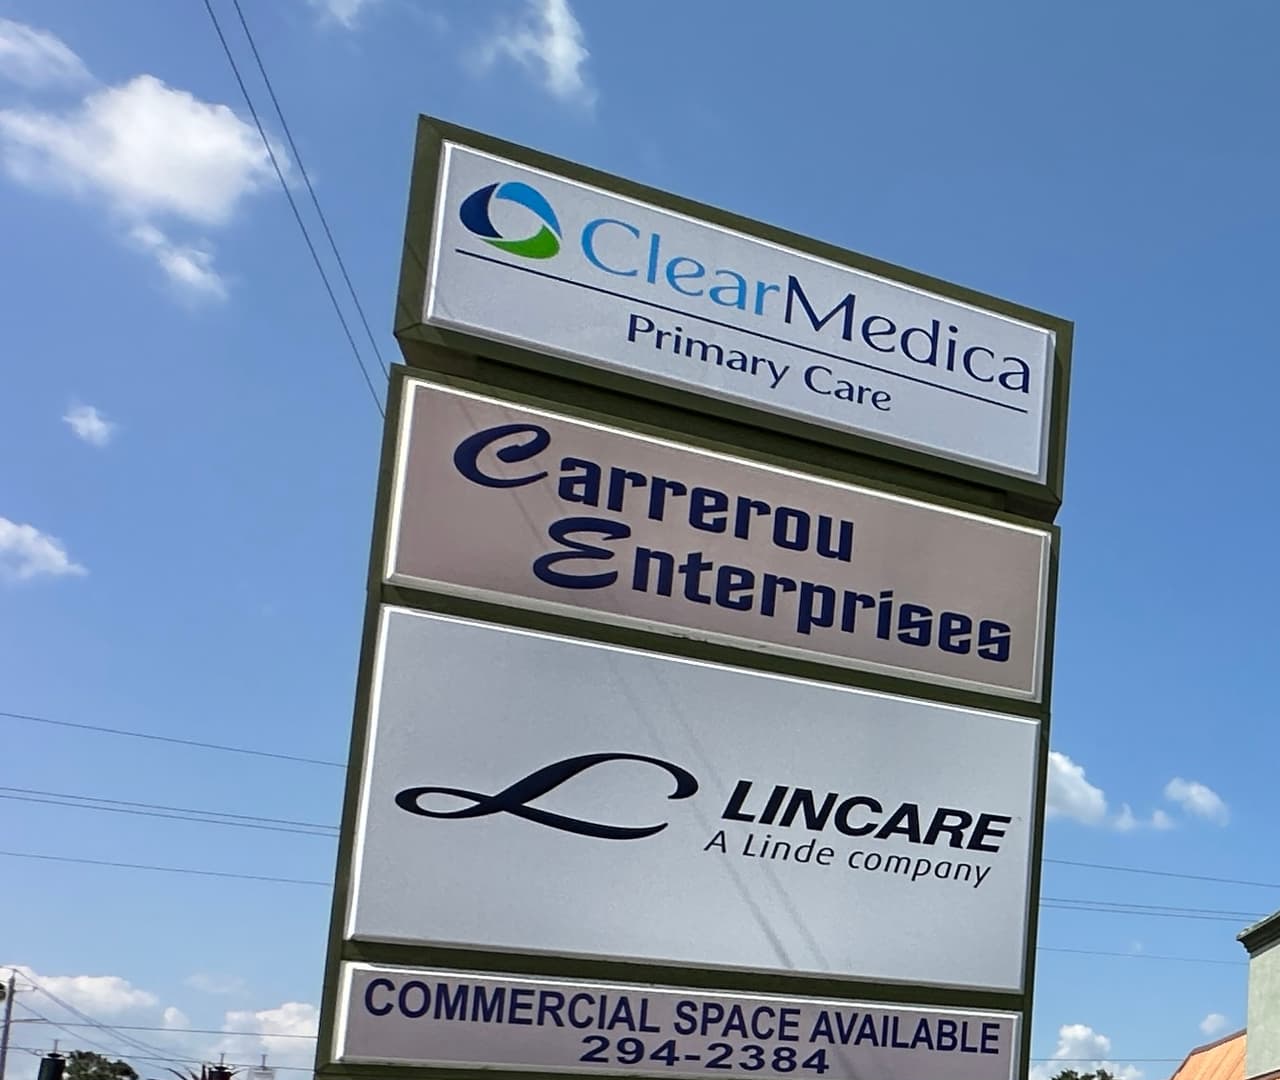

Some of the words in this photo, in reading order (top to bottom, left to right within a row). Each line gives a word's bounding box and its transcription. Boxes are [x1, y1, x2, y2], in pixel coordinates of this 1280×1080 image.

[580, 218, 1032, 395] ClearMedica
[627, 313, 790, 389] Primary
[804, 365, 893, 413] Care
[453, 423, 854, 563] Carrerou
[532, 516, 1012, 663] Enterprises
[703, 830, 728, 854] A
[742, 833, 836, 867] Linde
[847, 851, 993, 889] company
[721, 780, 1013, 854] LINCARE
[364, 977, 661, 1034] COMMERCIAL
[673, 1000, 801, 1042] SPACE
[808, 1010, 1001, 1055] AVAILABLE
[578, 1035, 830, 1076] 294-2384
